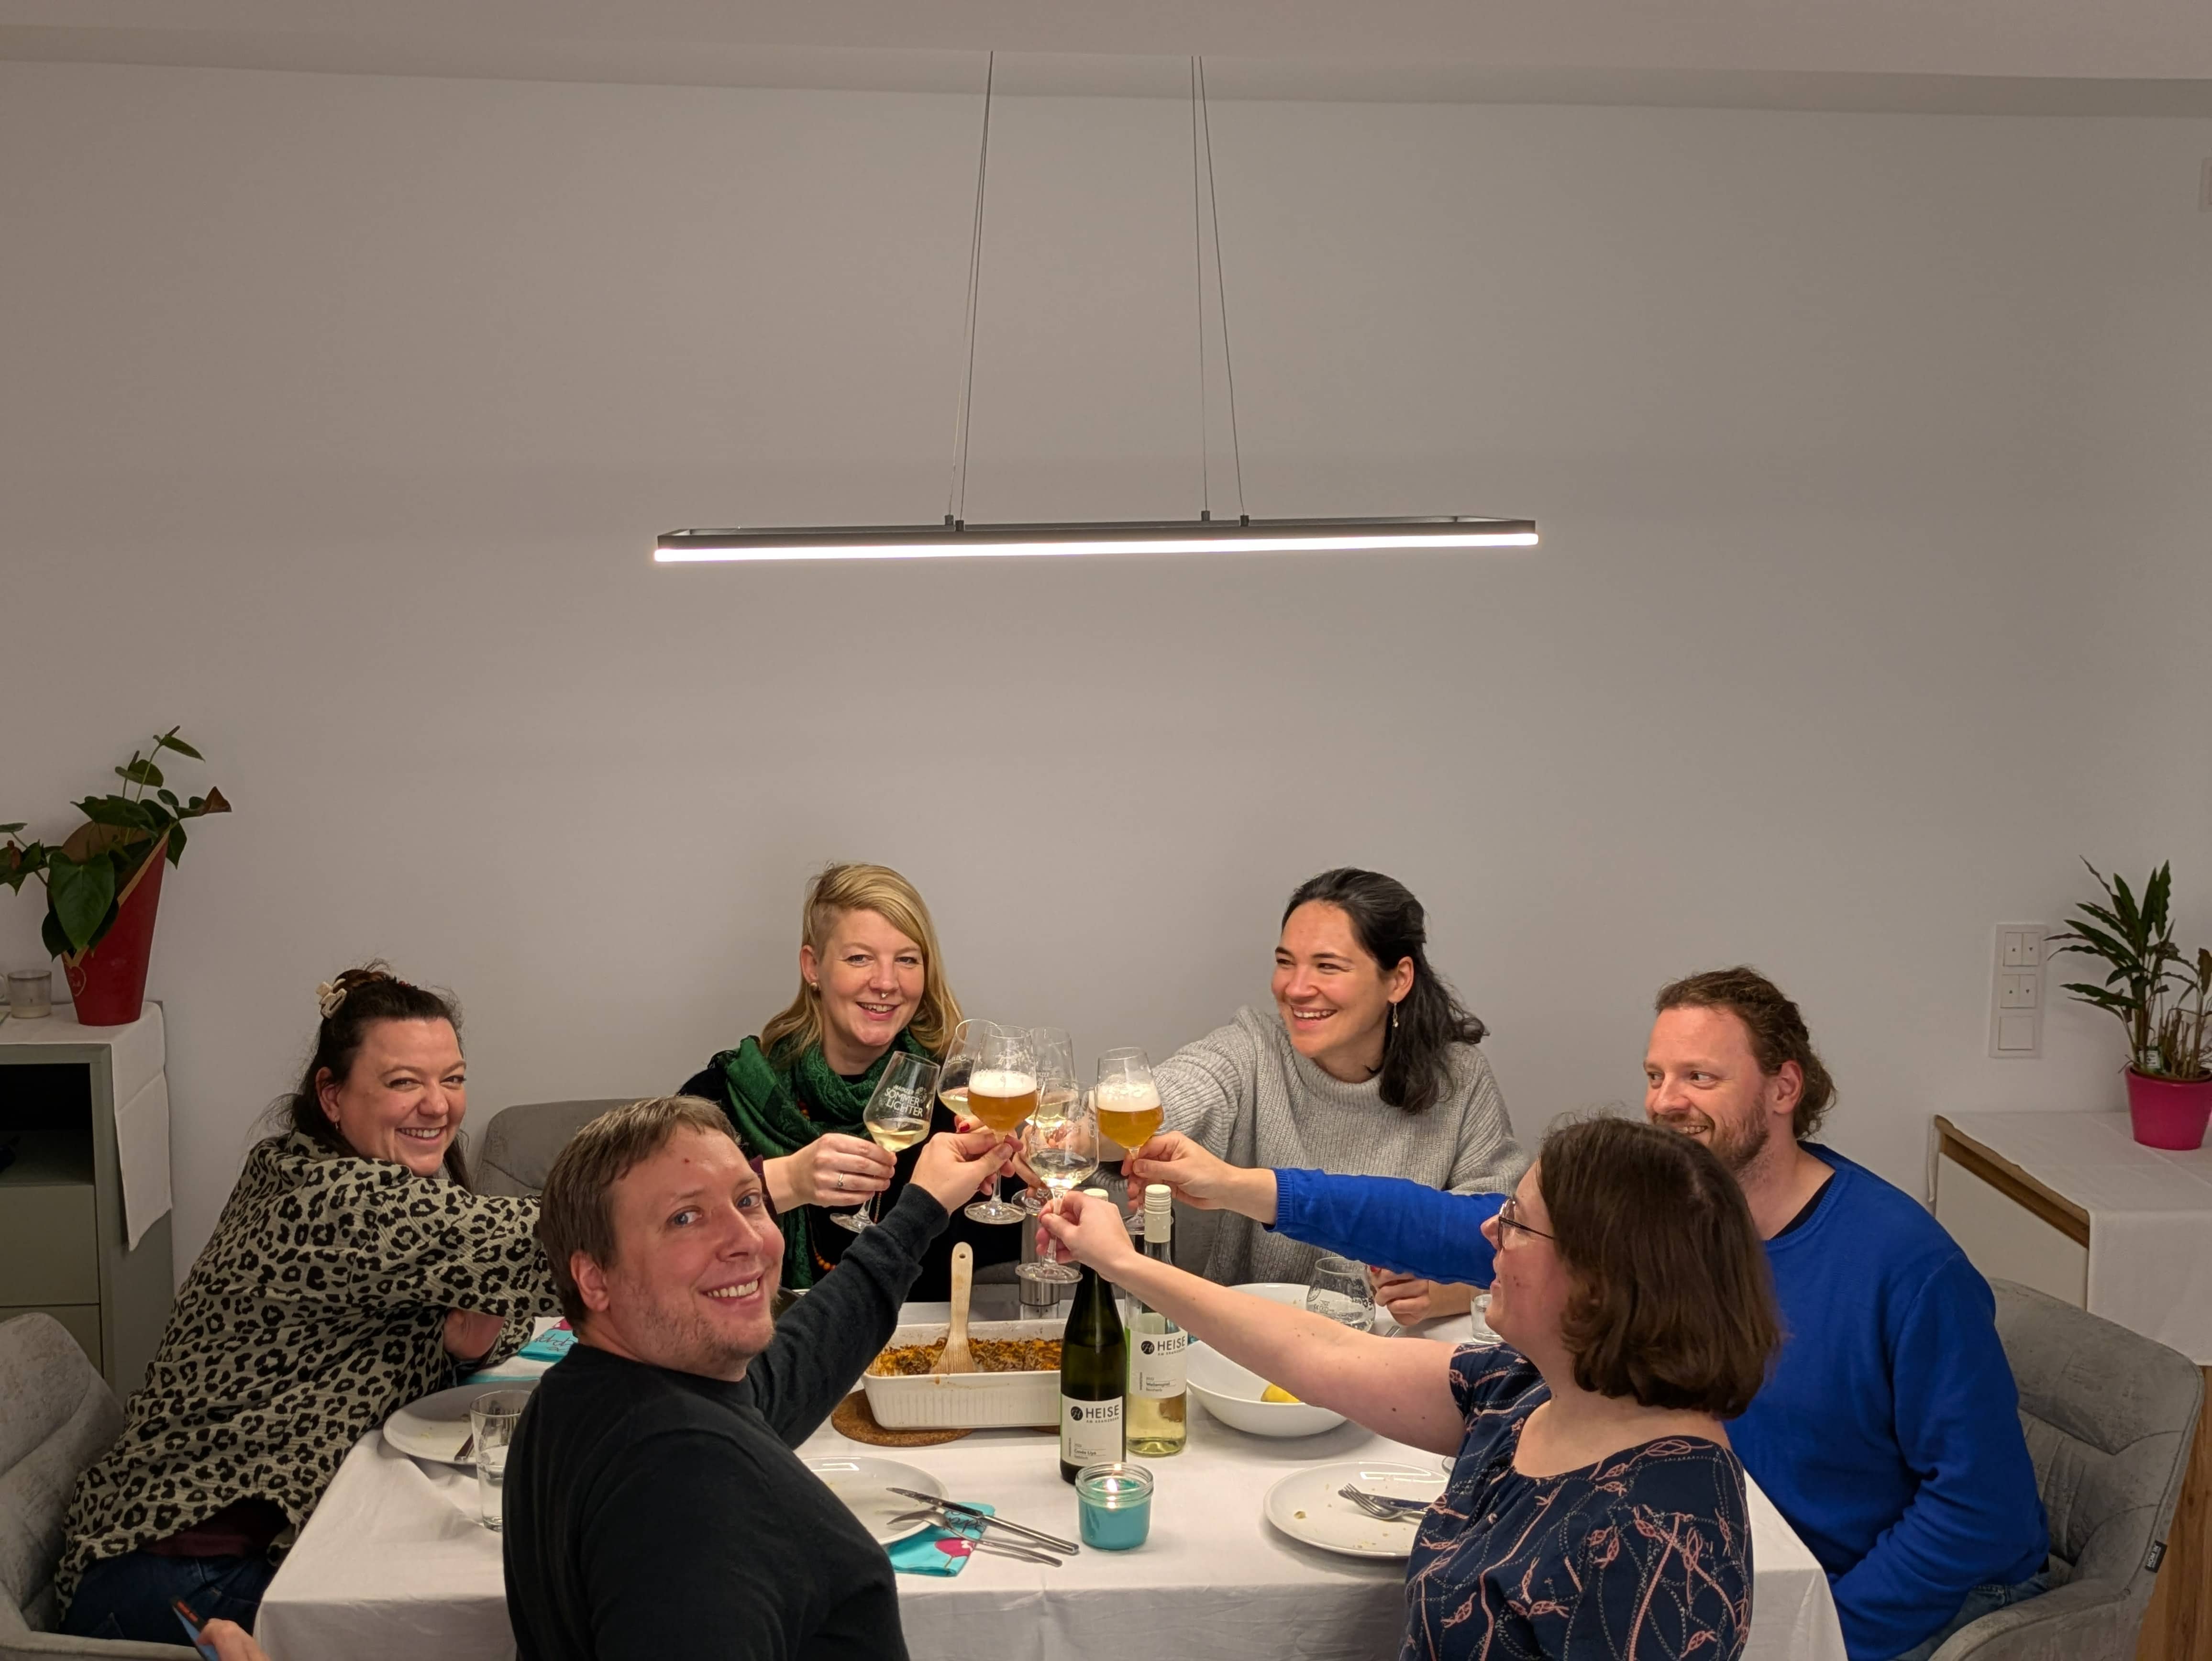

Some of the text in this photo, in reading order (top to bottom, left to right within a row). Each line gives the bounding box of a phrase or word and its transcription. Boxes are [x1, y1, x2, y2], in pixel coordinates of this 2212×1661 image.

[885, 1088, 919, 1107] SOMMER
[1158, 1336, 1185, 1351] HEISE
[1085, 1404, 1119, 1418] HEISE
